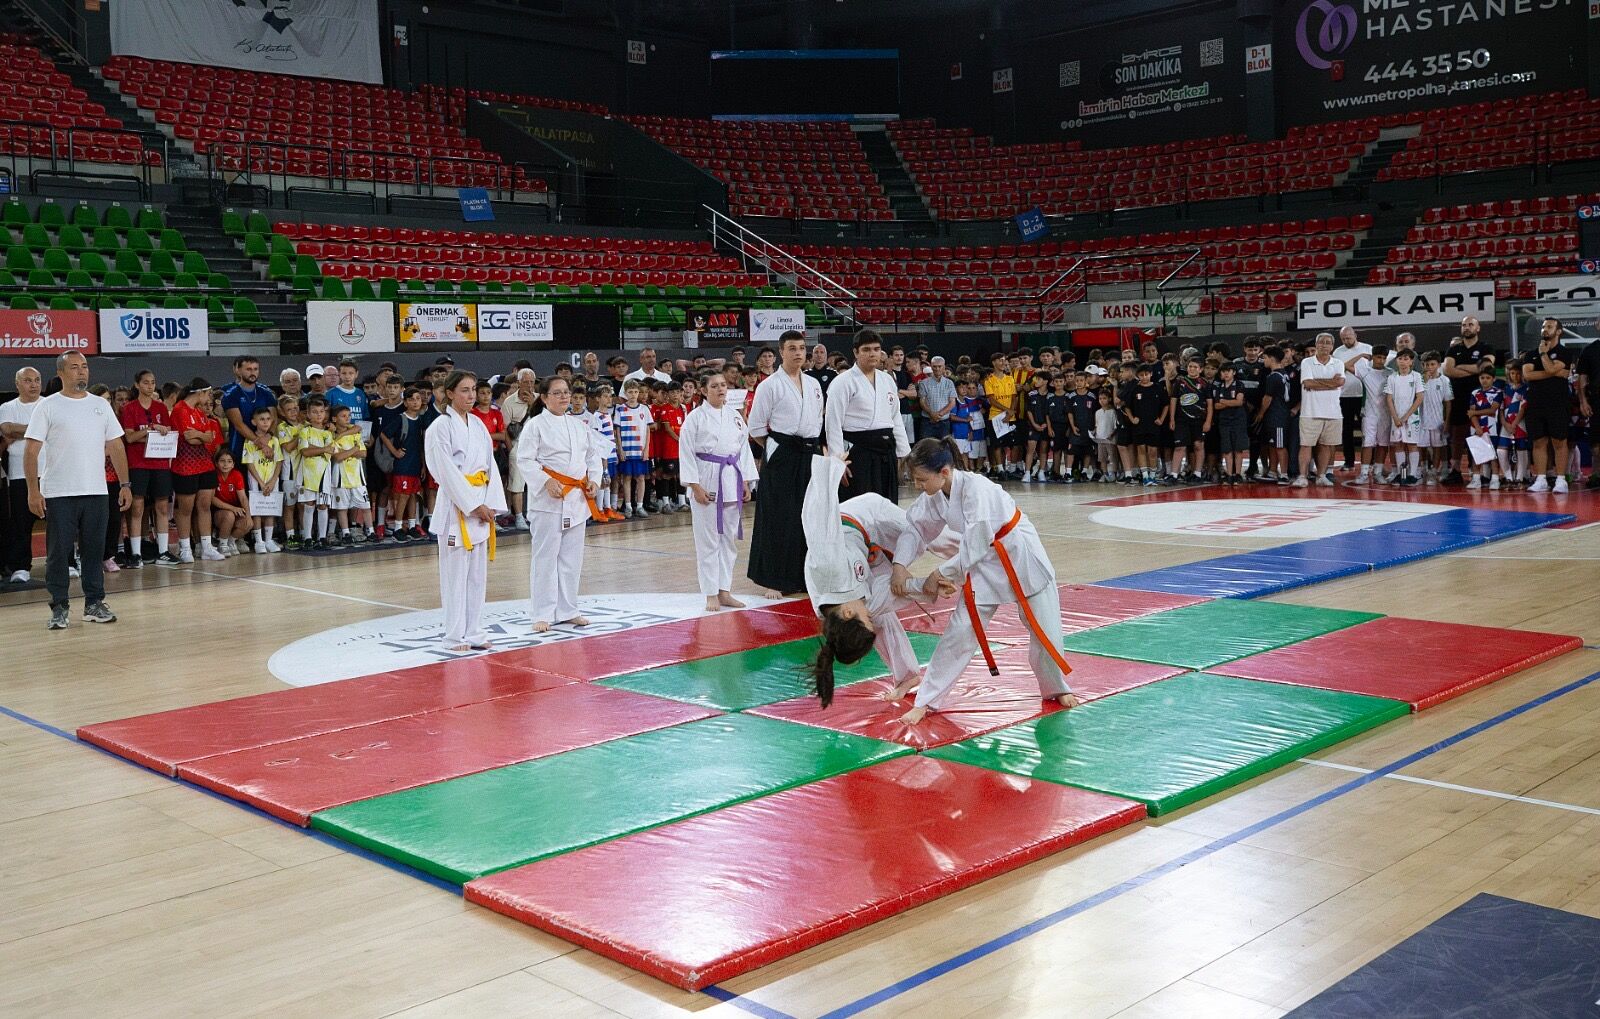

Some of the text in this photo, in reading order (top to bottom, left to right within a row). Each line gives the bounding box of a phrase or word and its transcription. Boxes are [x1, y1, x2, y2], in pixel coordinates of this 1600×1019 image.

[1366, 0, 1571, 40] HASTANE
[1251, 47, 1267, 59] D-1
[1115, 57, 1182, 84] SON DAKİKA
[1247, 58, 1271, 72] BLOK
[1364, 48, 1491, 84] 444 35 50
[1122, 92, 1160, 110] Haber
[1160, 81, 1210, 104] Merkezi
[1323, 69, 1537, 110] www.metropolhatanesi.com
[1023, 221, 1045, 236] BLOK
[416, 306, 459, 316] ÖNERMAK
[1102, 302, 1186, 321] KARŞIYAKA
[1299, 291, 1494, 320] FOLKART
[708, 313, 740, 327] ASY
[571, 353, 581, 368] C
[402, 480, 408, 490] 2
